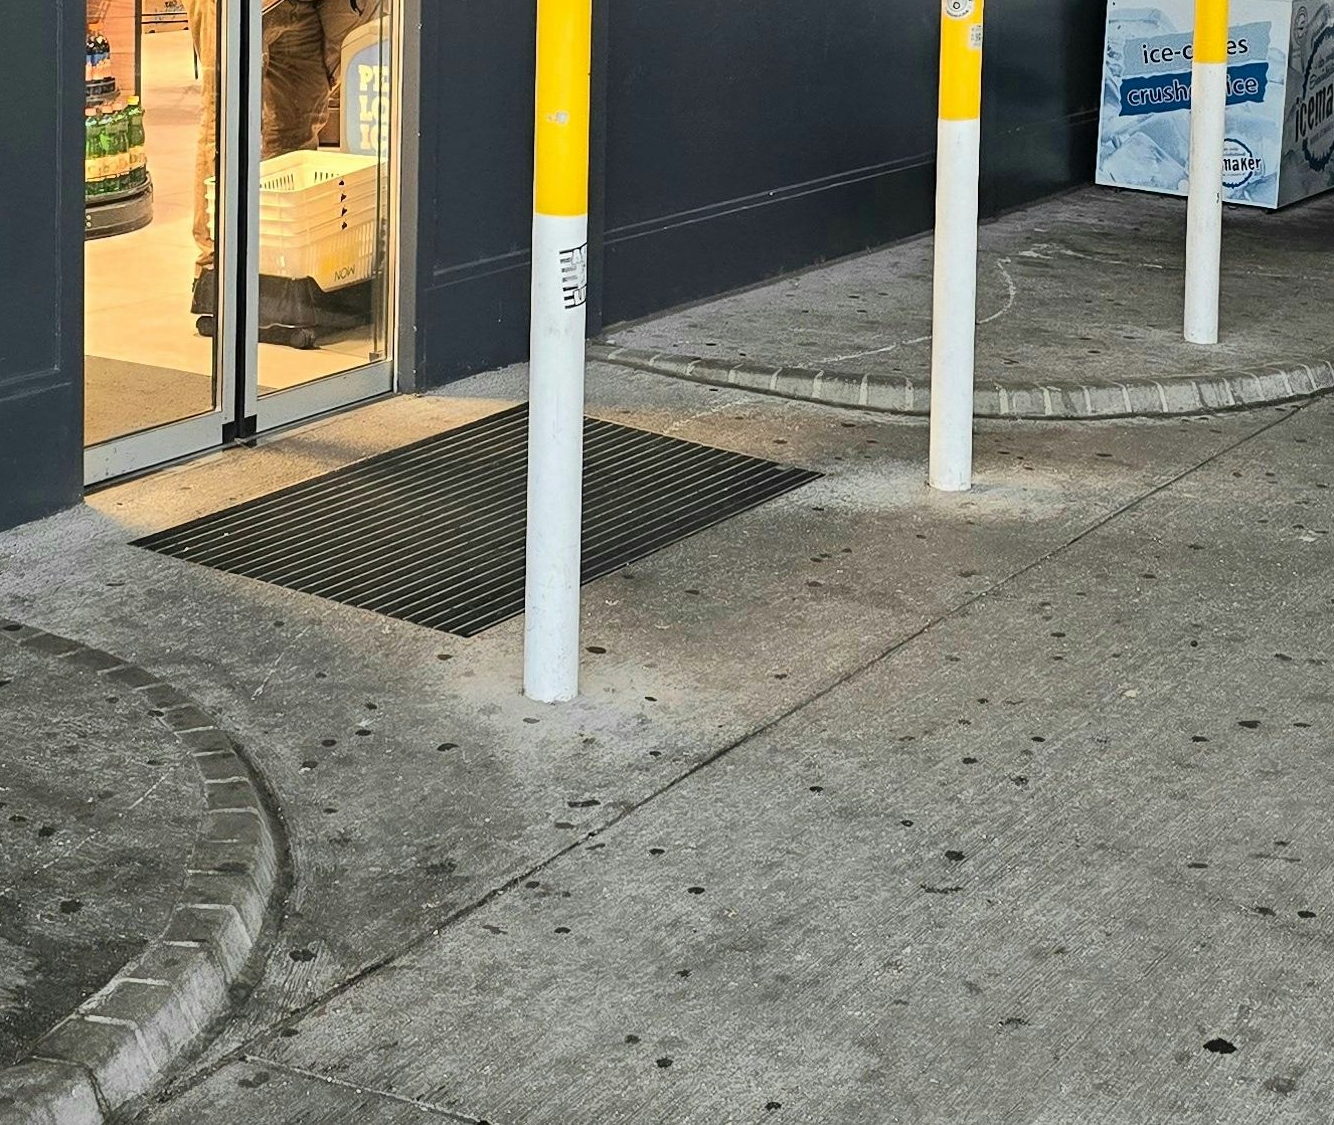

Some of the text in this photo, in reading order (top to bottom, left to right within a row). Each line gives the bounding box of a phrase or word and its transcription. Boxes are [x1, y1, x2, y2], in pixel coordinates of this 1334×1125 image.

[1142, 37, 1248, 64] ice-ces
[1127, 74, 1259, 107] crush ice
[1223, 157, 1262, 172] maker
[333, 263, 356, 282] NOW
